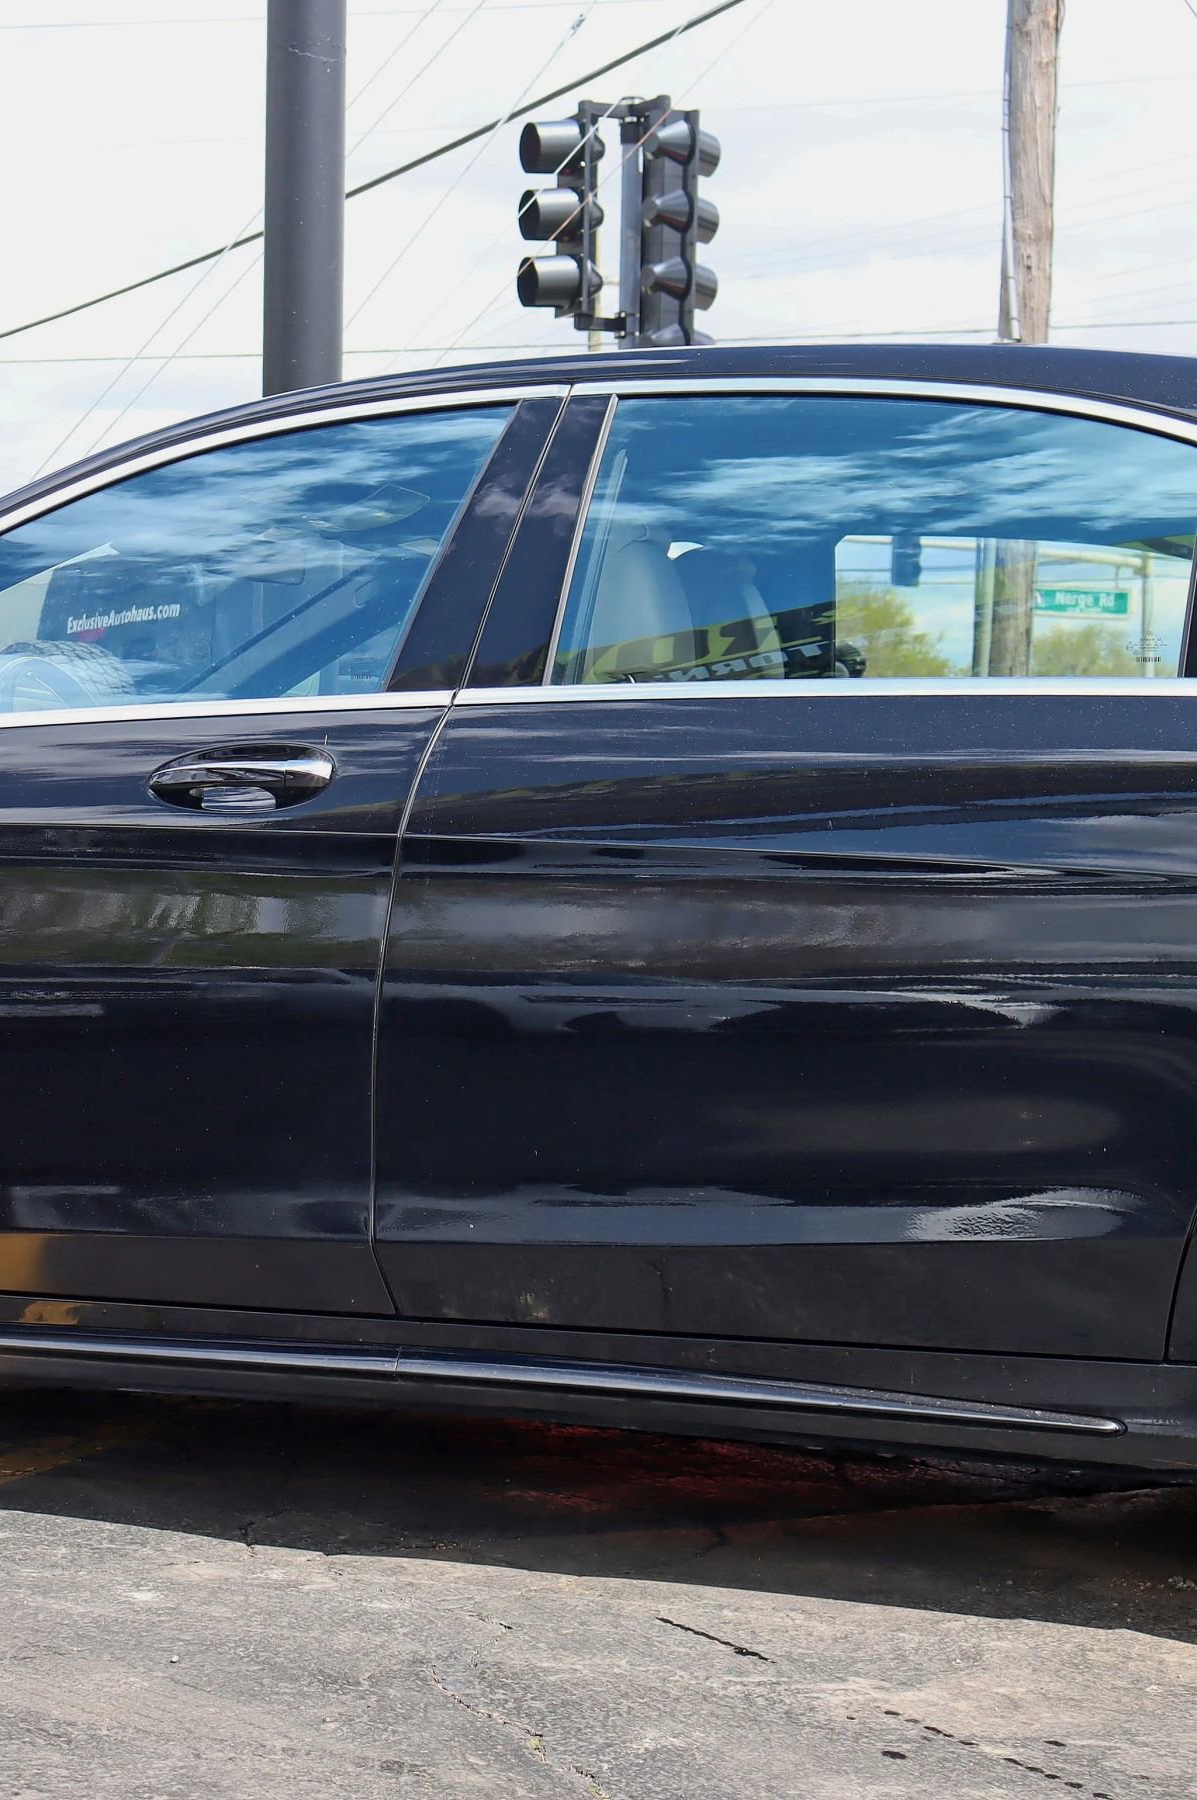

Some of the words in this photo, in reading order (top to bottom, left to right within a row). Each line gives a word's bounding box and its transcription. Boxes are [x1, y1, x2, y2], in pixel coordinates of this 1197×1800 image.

[1055, 591, 1094, 608] Nerge
[1099, 592, 1115, 608] Rd
[67, 603, 181, 634] ExclusiveAutohaus.com
